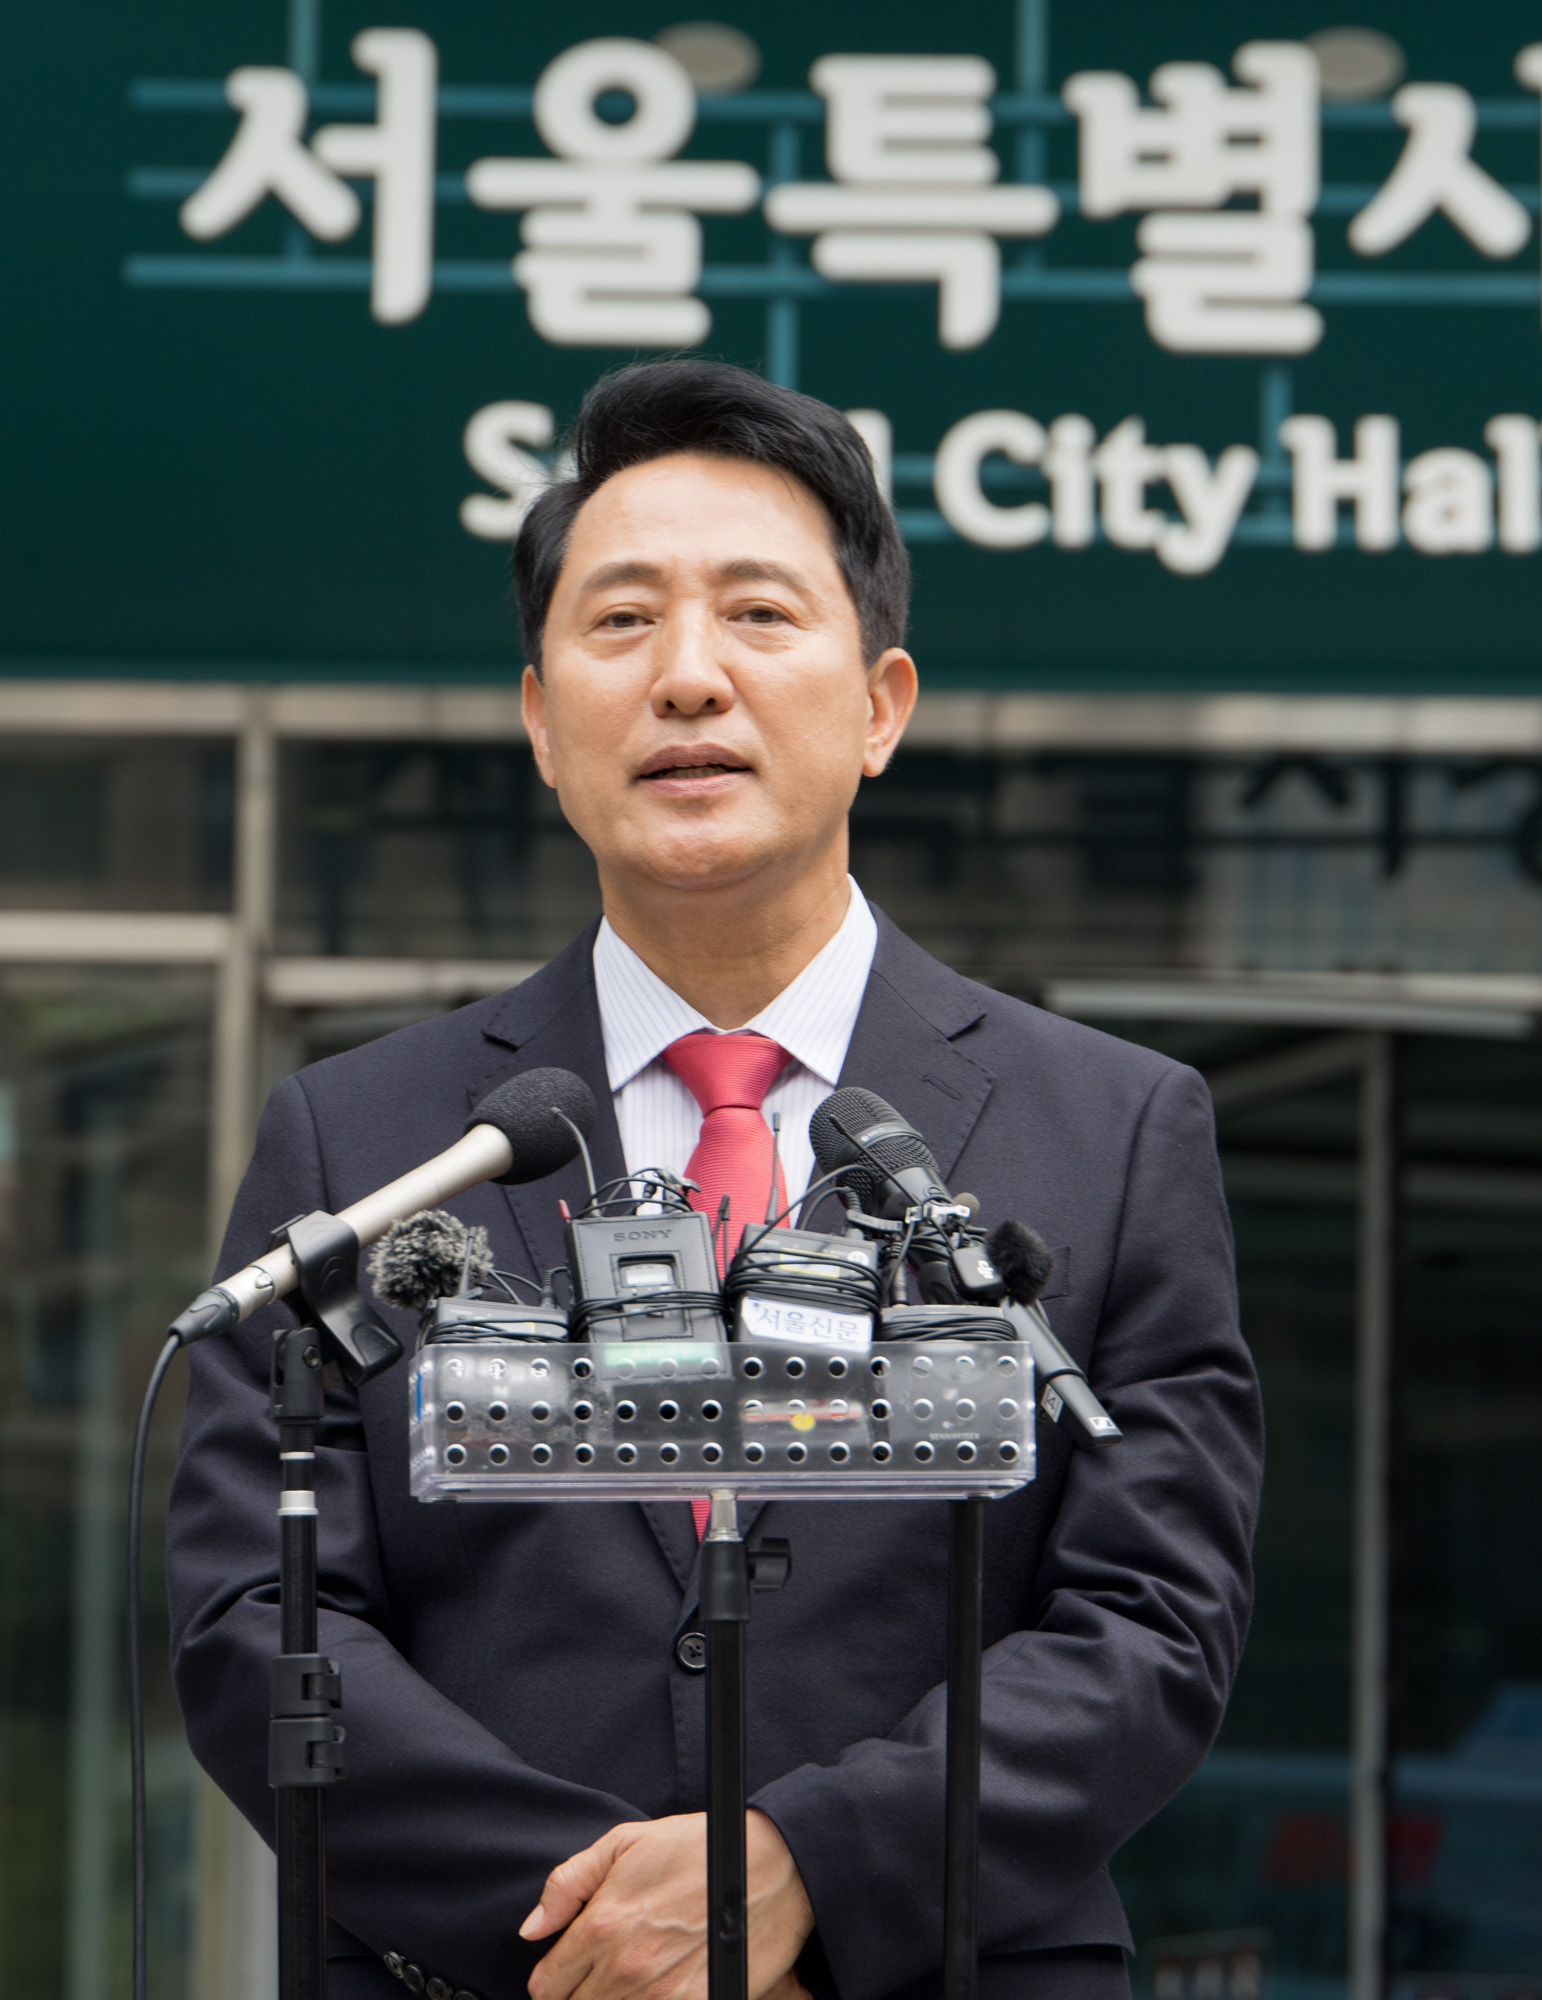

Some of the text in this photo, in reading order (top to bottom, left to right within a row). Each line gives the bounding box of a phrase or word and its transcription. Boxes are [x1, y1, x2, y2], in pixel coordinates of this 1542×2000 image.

[932, 410, 1260, 575] City
[1277, 413, 1542, 554] Hal
[613, 1229, 672, 1241] SONY
